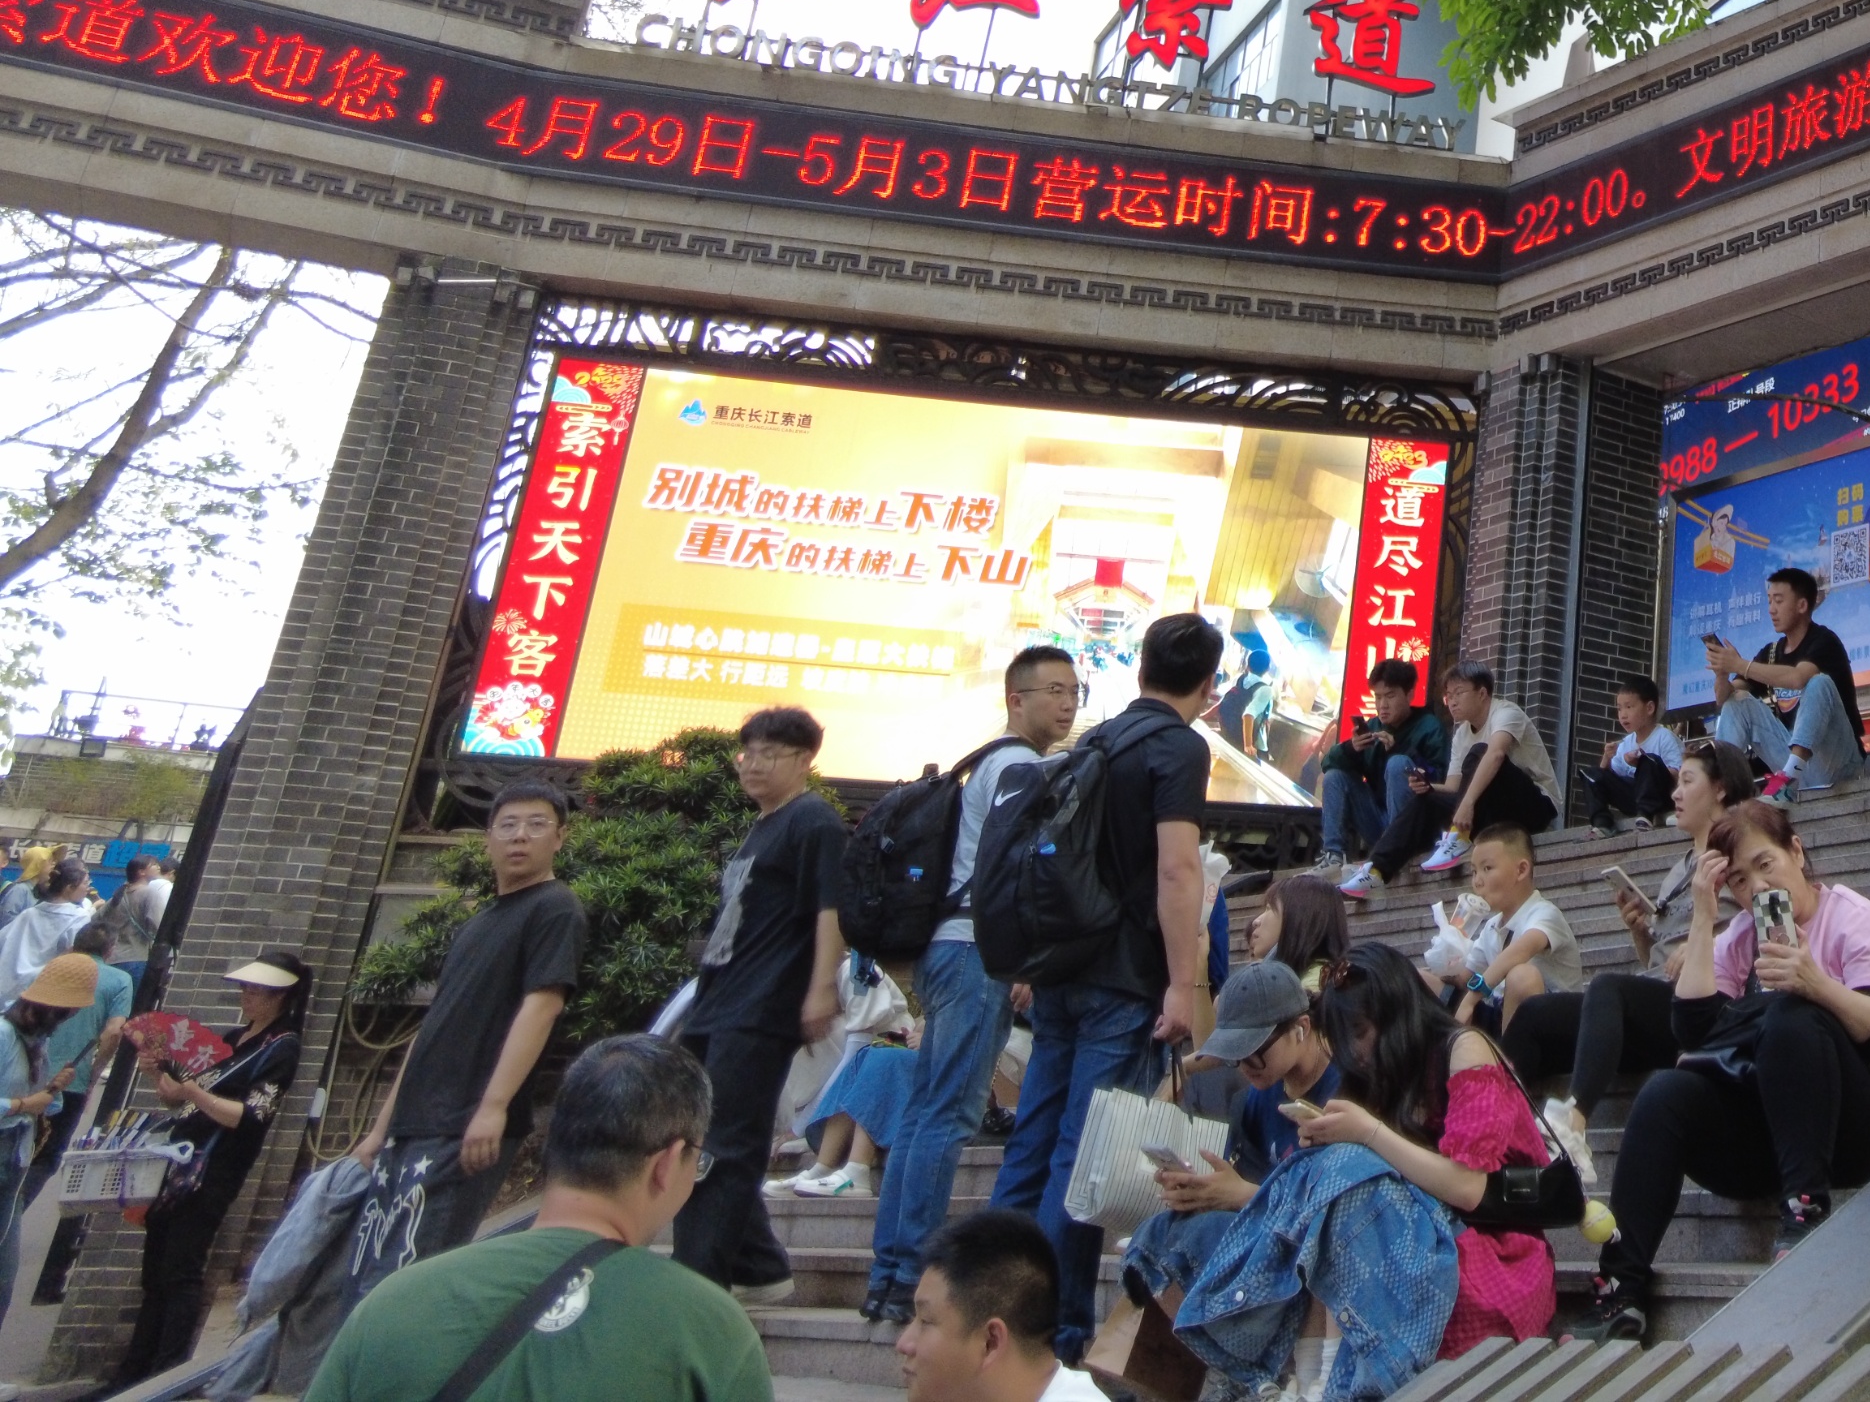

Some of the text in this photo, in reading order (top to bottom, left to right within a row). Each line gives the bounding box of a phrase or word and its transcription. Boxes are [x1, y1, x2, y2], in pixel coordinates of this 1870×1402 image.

[988, 60, 1211, 116] YANGTZE
[1237, 94, 1466, 150] ROPEWAY
[713, 405, 812, 429] 重庆长江索道
[647, 466, 998, 534] 别城的扶梯上下楼
[503, 411, 609, 678] 索引天下客
[681, 521, 1030, 586] 重庆的扶梯上下山
[1359, 485, 1426, 722] 道尽江山
